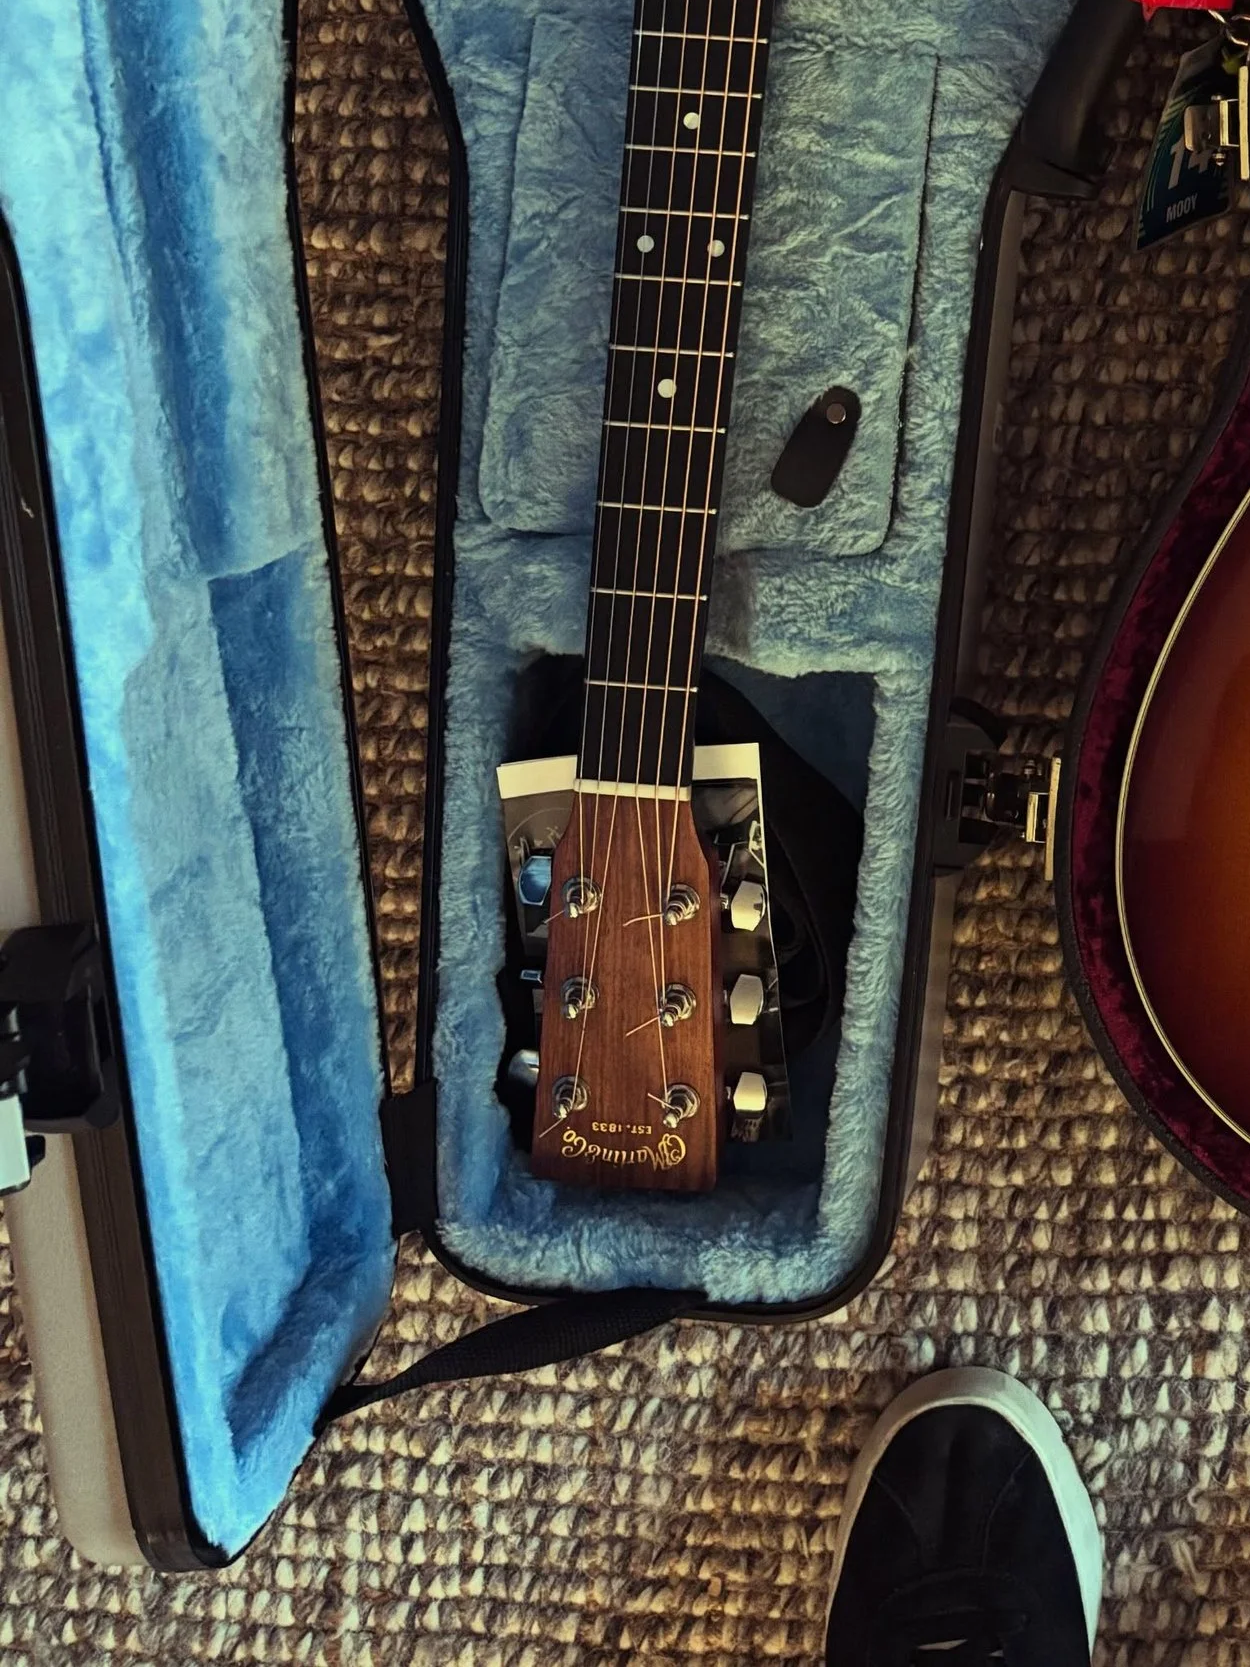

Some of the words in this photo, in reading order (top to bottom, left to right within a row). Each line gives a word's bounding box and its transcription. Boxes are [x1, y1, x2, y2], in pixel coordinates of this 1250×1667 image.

[1165, 192, 1198, 223] MOOY
[591, 1121, 622, 1133] 1833
[626, 1124, 652, 1135] EST.
